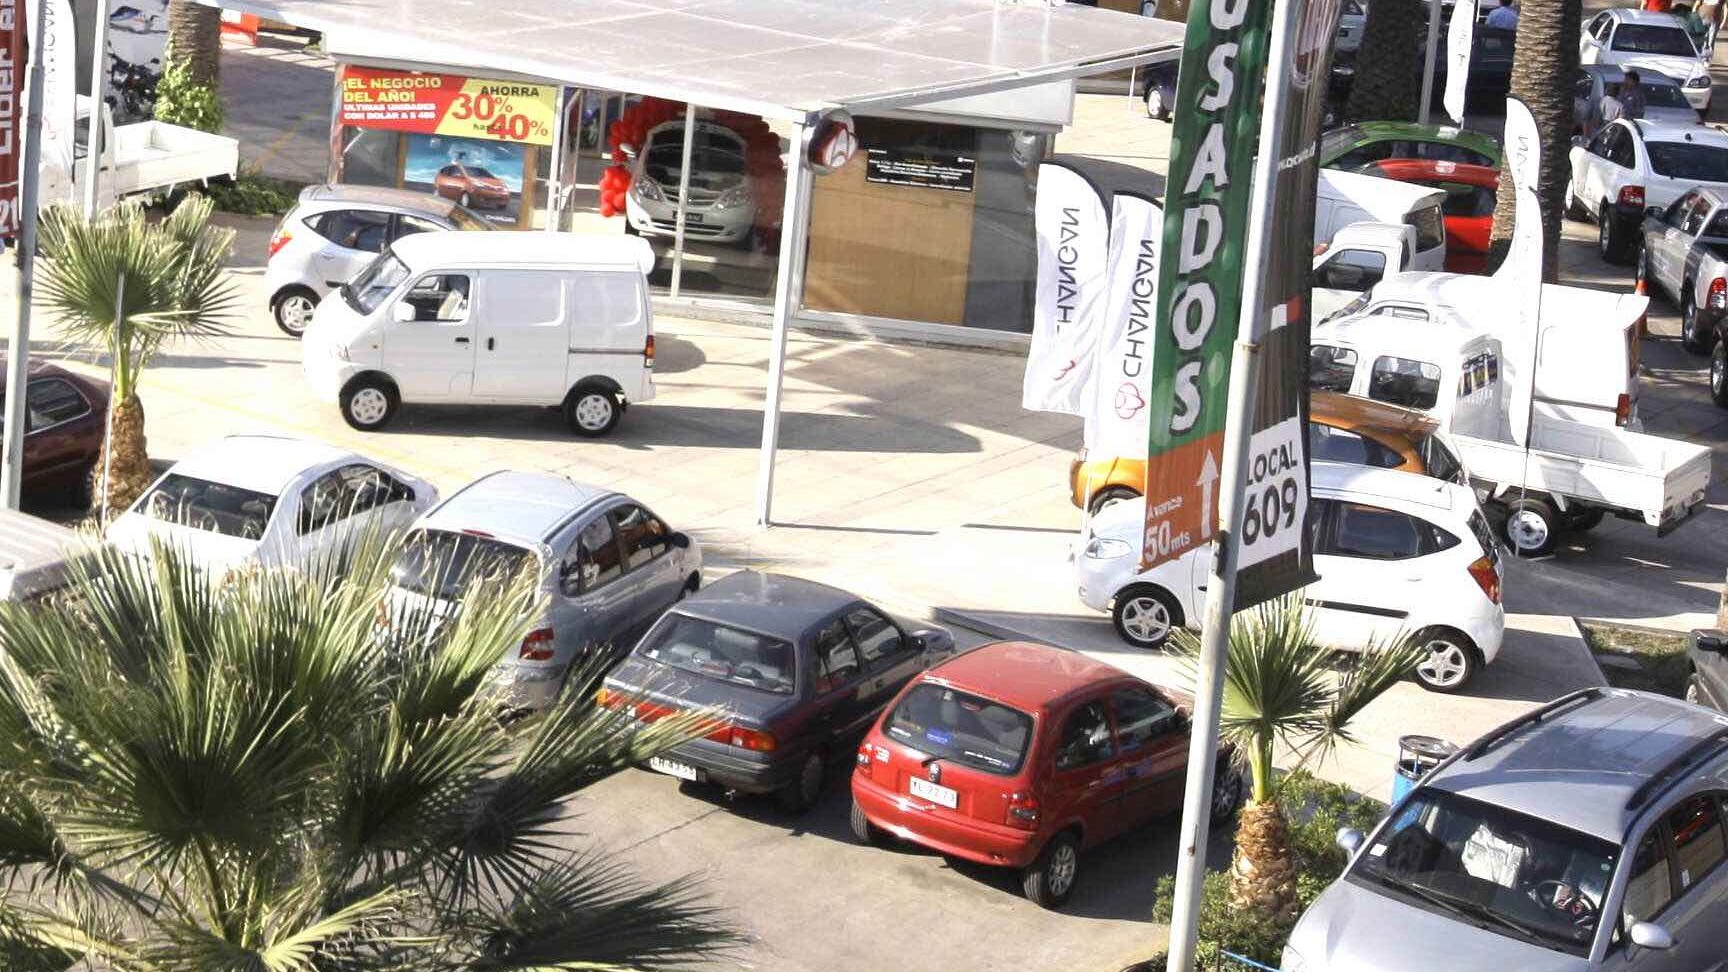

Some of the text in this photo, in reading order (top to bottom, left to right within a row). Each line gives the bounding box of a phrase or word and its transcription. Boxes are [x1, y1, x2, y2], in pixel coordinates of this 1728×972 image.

[343, 91, 373, 103] DEL
[370, 77, 442, 89] NEGOCIO
[480, 85, 540, 97] AHORRA
[451, 93, 513, 121] 30%
[486, 113, 549, 141] 40%
[1246, 439, 1299, 486] LOCAL
[1241, 477, 1299, 547] 609
